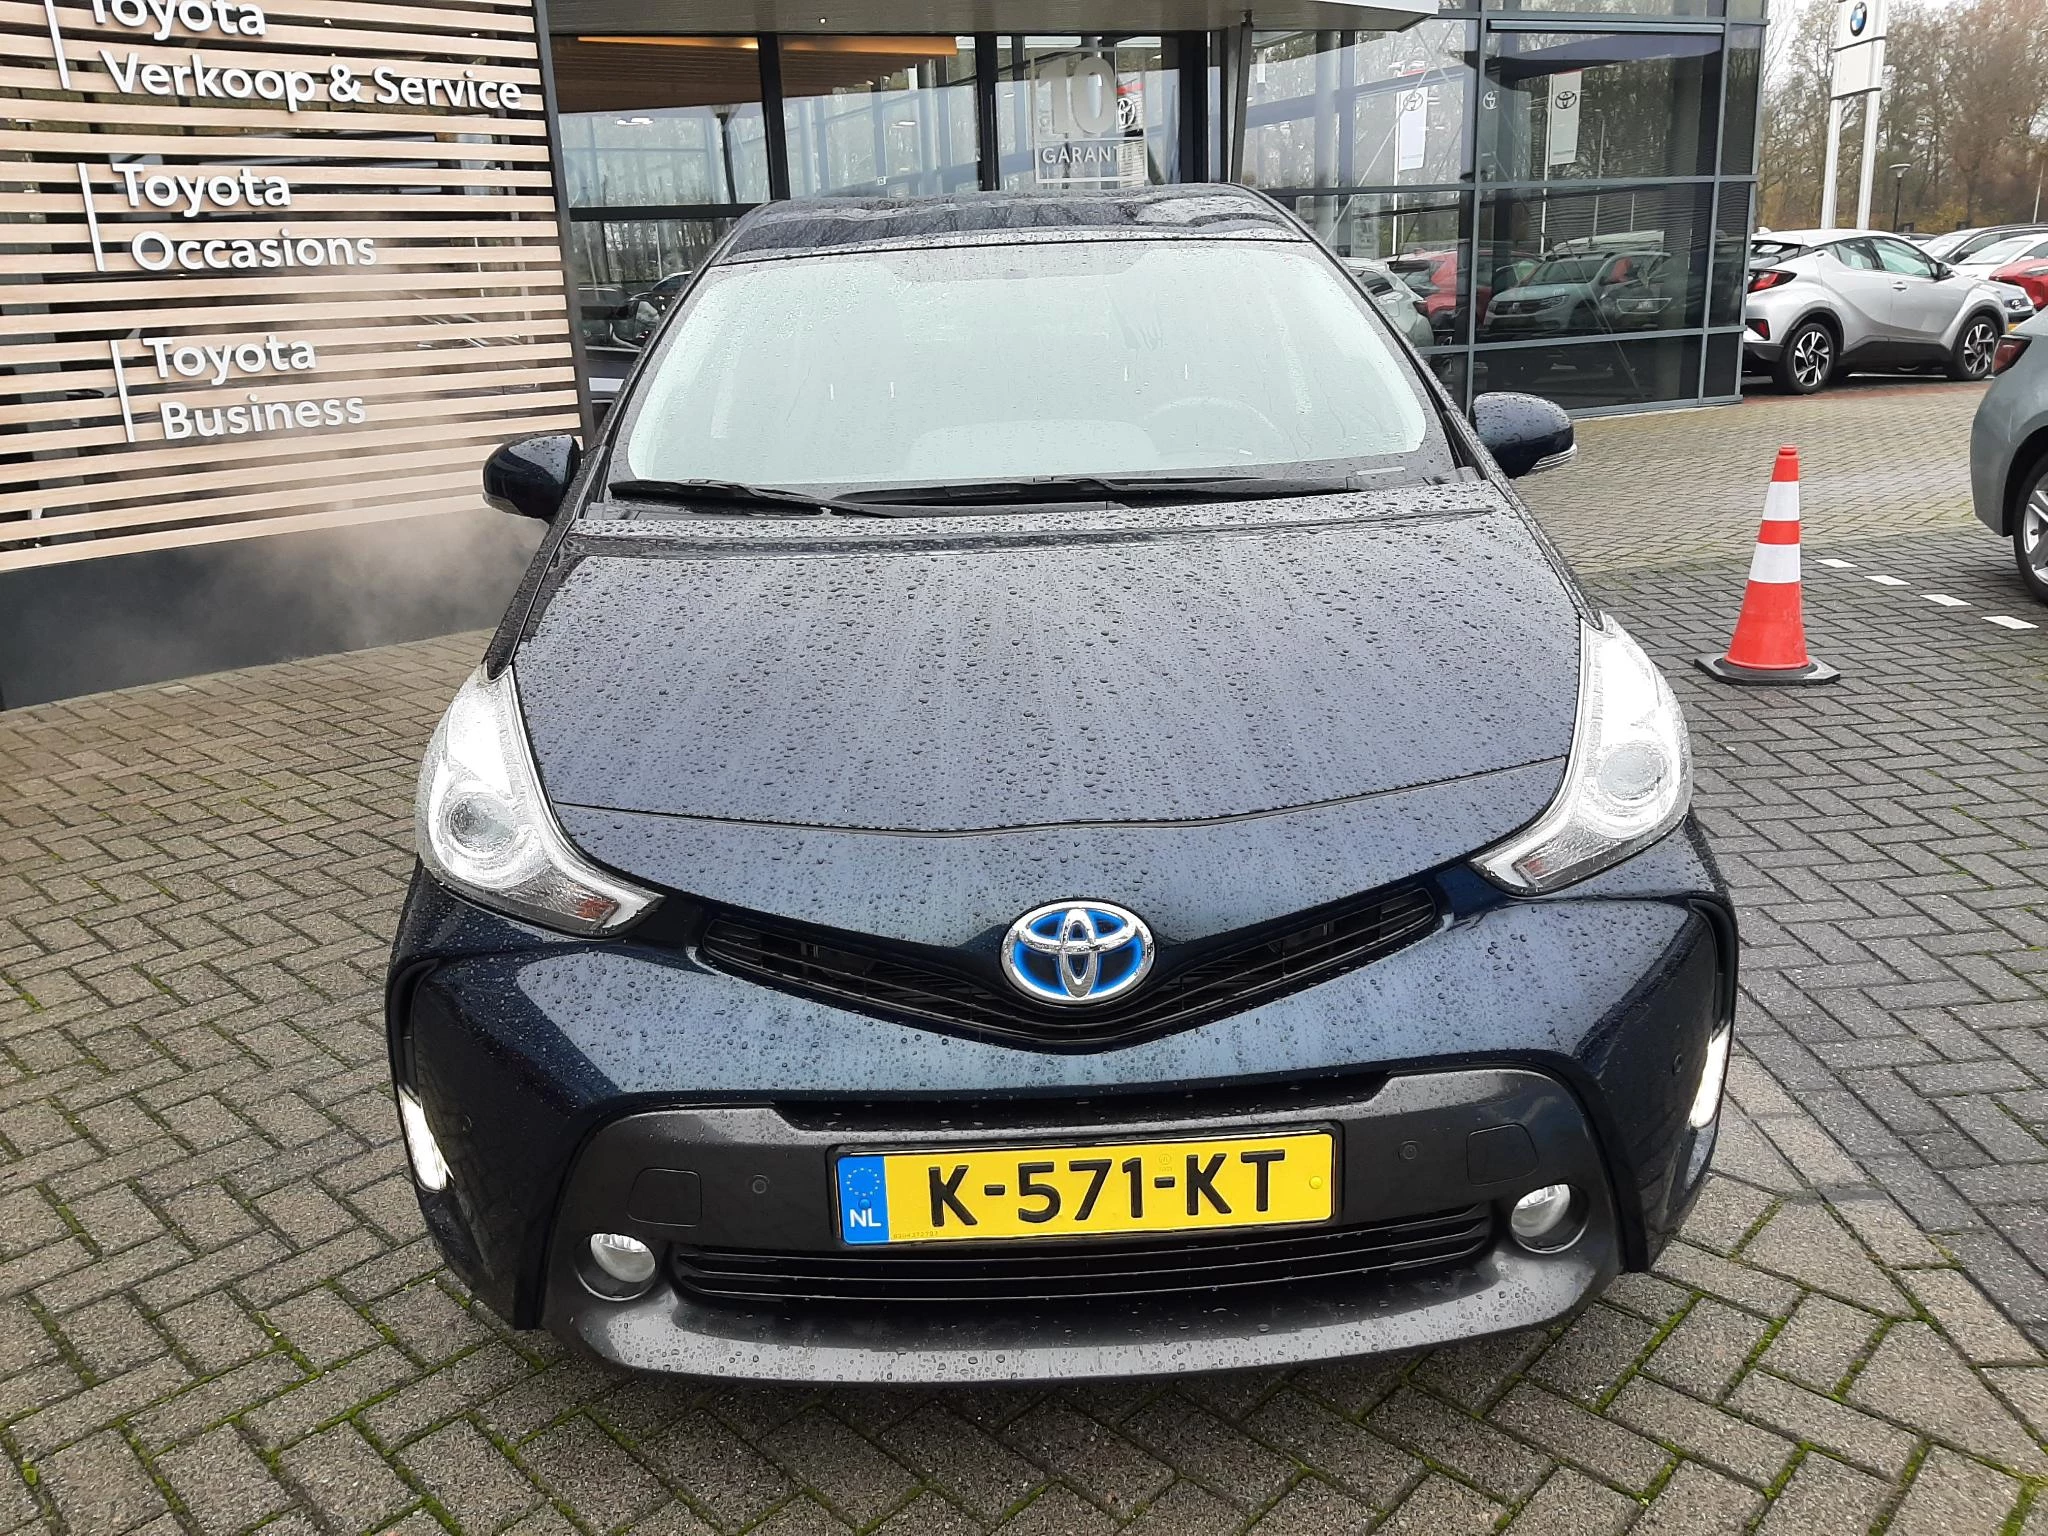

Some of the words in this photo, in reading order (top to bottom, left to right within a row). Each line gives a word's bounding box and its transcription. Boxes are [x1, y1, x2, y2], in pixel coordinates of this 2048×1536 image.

[100, 50, 316, 112] Verkoop
[329, 63, 362, 103] &
[373, 66, 522, 110] Service
[113, 163, 292, 217] Toyota
[131, 228, 377, 272] Occasions
[143, 334, 318, 386] Toyota
[160, 393, 366, 440] Business
[928, 1149, 1286, 1228] K-571-KT
[848, 1208, 883, 1230] NL
